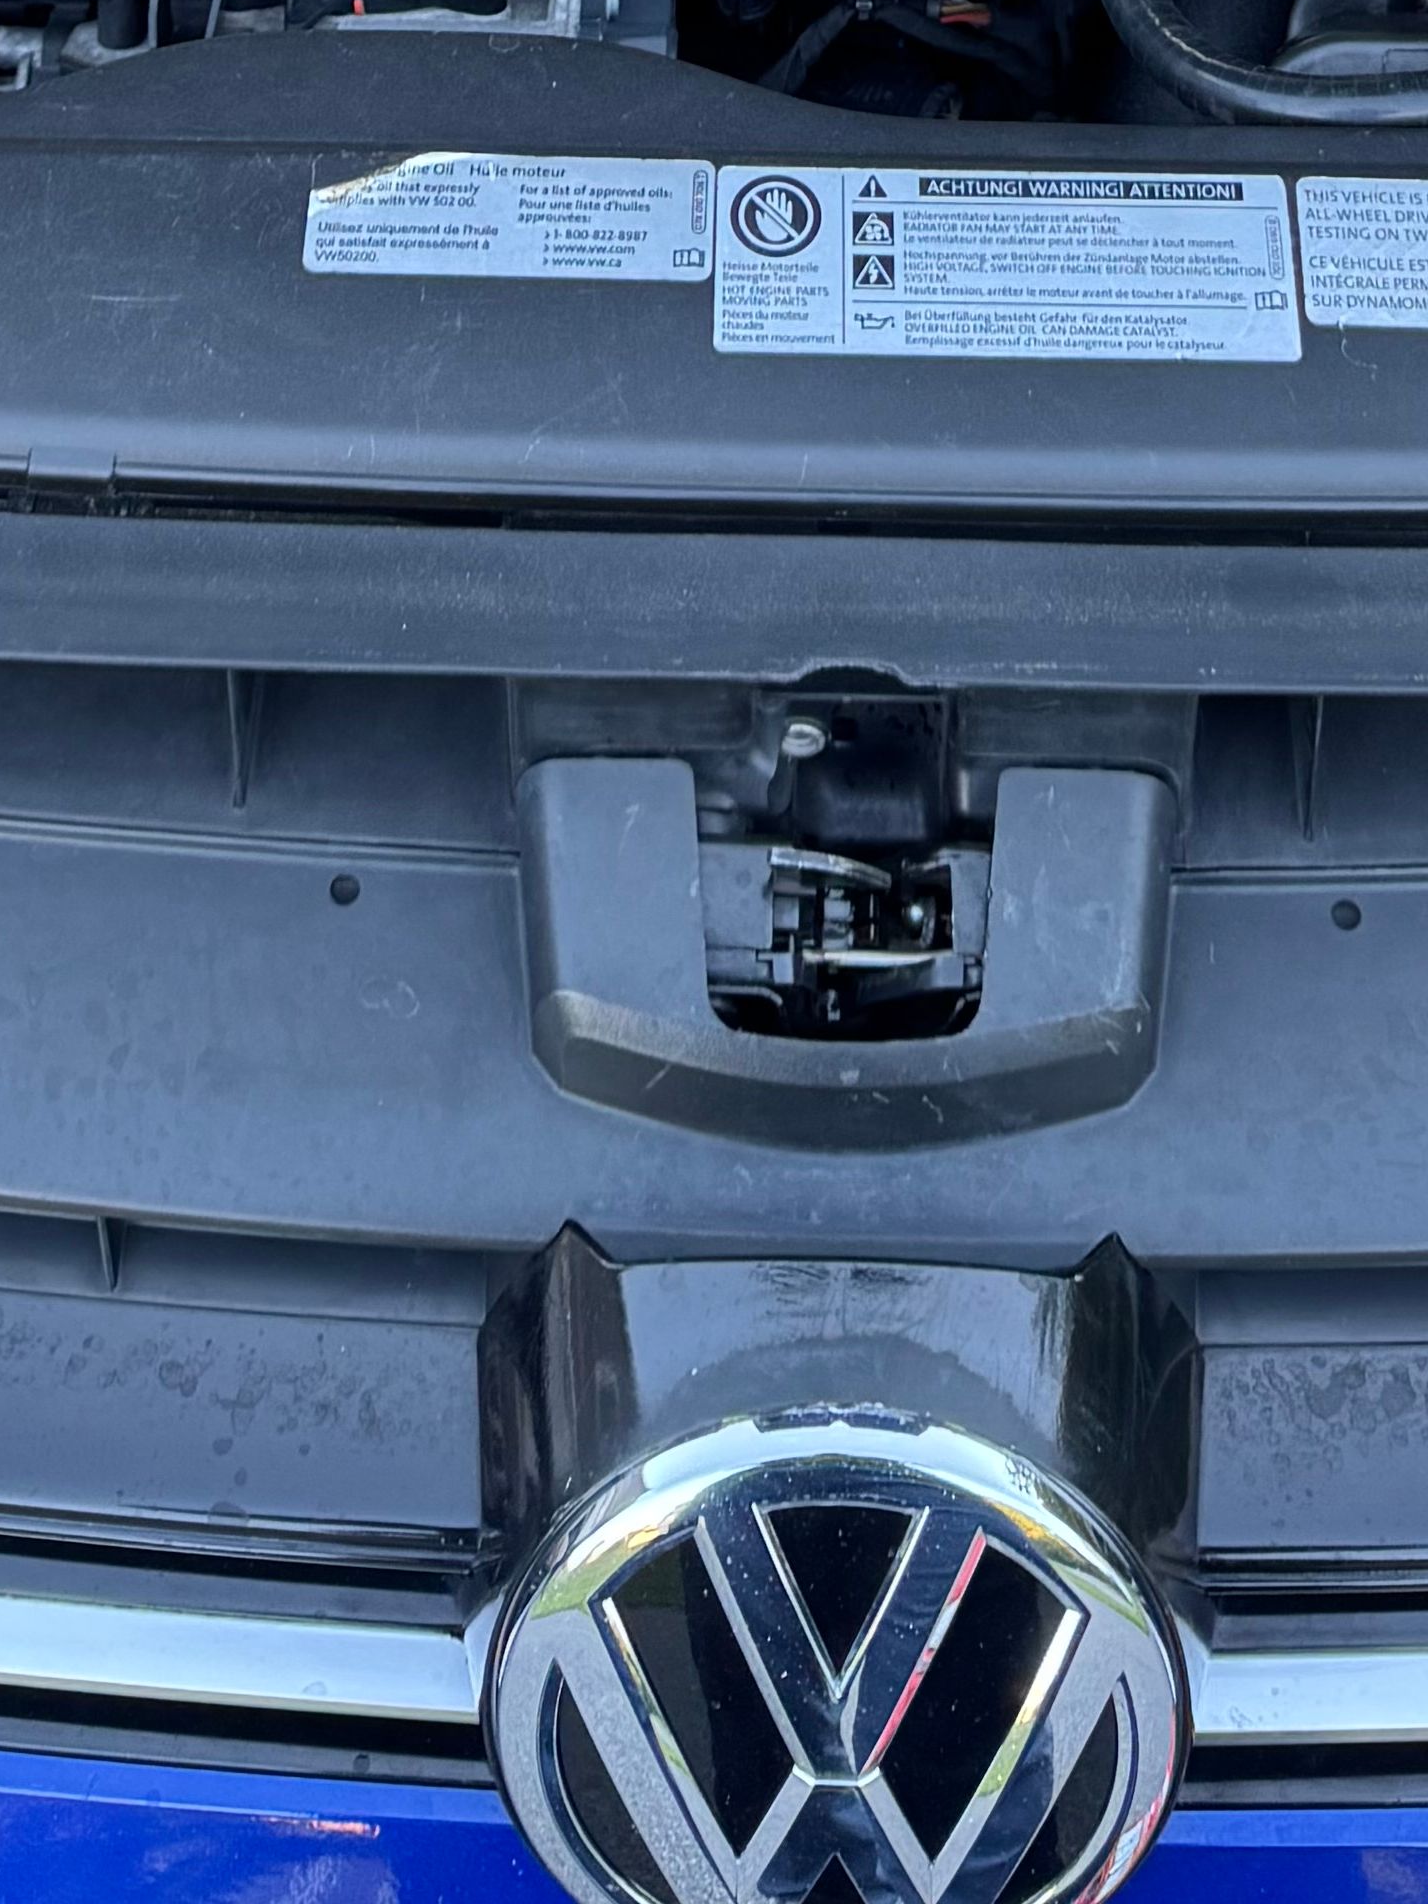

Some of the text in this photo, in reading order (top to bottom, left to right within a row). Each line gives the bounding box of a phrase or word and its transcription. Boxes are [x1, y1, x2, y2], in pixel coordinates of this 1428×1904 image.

[377, 180, 392, 191] oil
[396, 182, 420, 192] that
[424, 183, 480, 196] expressly
[518, 182, 672, 200] For a list of approved oils:
[927, 180, 1235, 199] ACHTUNG! WARNING! ATTENTION!
[377, 193, 406, 206] with
[407, 194, 430, 207] VW
[434, 195, 455, 207] 502
[458, 196, 476, 208] 00.
[517, 196, 651, 213] Pour une liste d'huiles
[1304, 189, 1338, 203] THIS
[1341, 190, 1405, 204] VEHICLE
[1408, 191, 1423, 206] IS
[1306, 208, 1391, 223] ALL-WHEEL
[318, 220, 498, 237] Utilisez uniquement de l'huile
[1308, 226, 1371, 240] TESTING
[1373, 226, 1400, 242] ON
[316, 236, 490, 252] qui satisfait expressément à
[553, 245, 635, 255] www.vw.com
[551, 256, 622, 268] www.vw.ca
[1307, 254, 1328, 270] CE
[1330, 255, 1404, 271] VÉHICULE
[1311, 274, 1390, 290] INTÉGRALE
[1310, 292, 1343, 309] SUR
